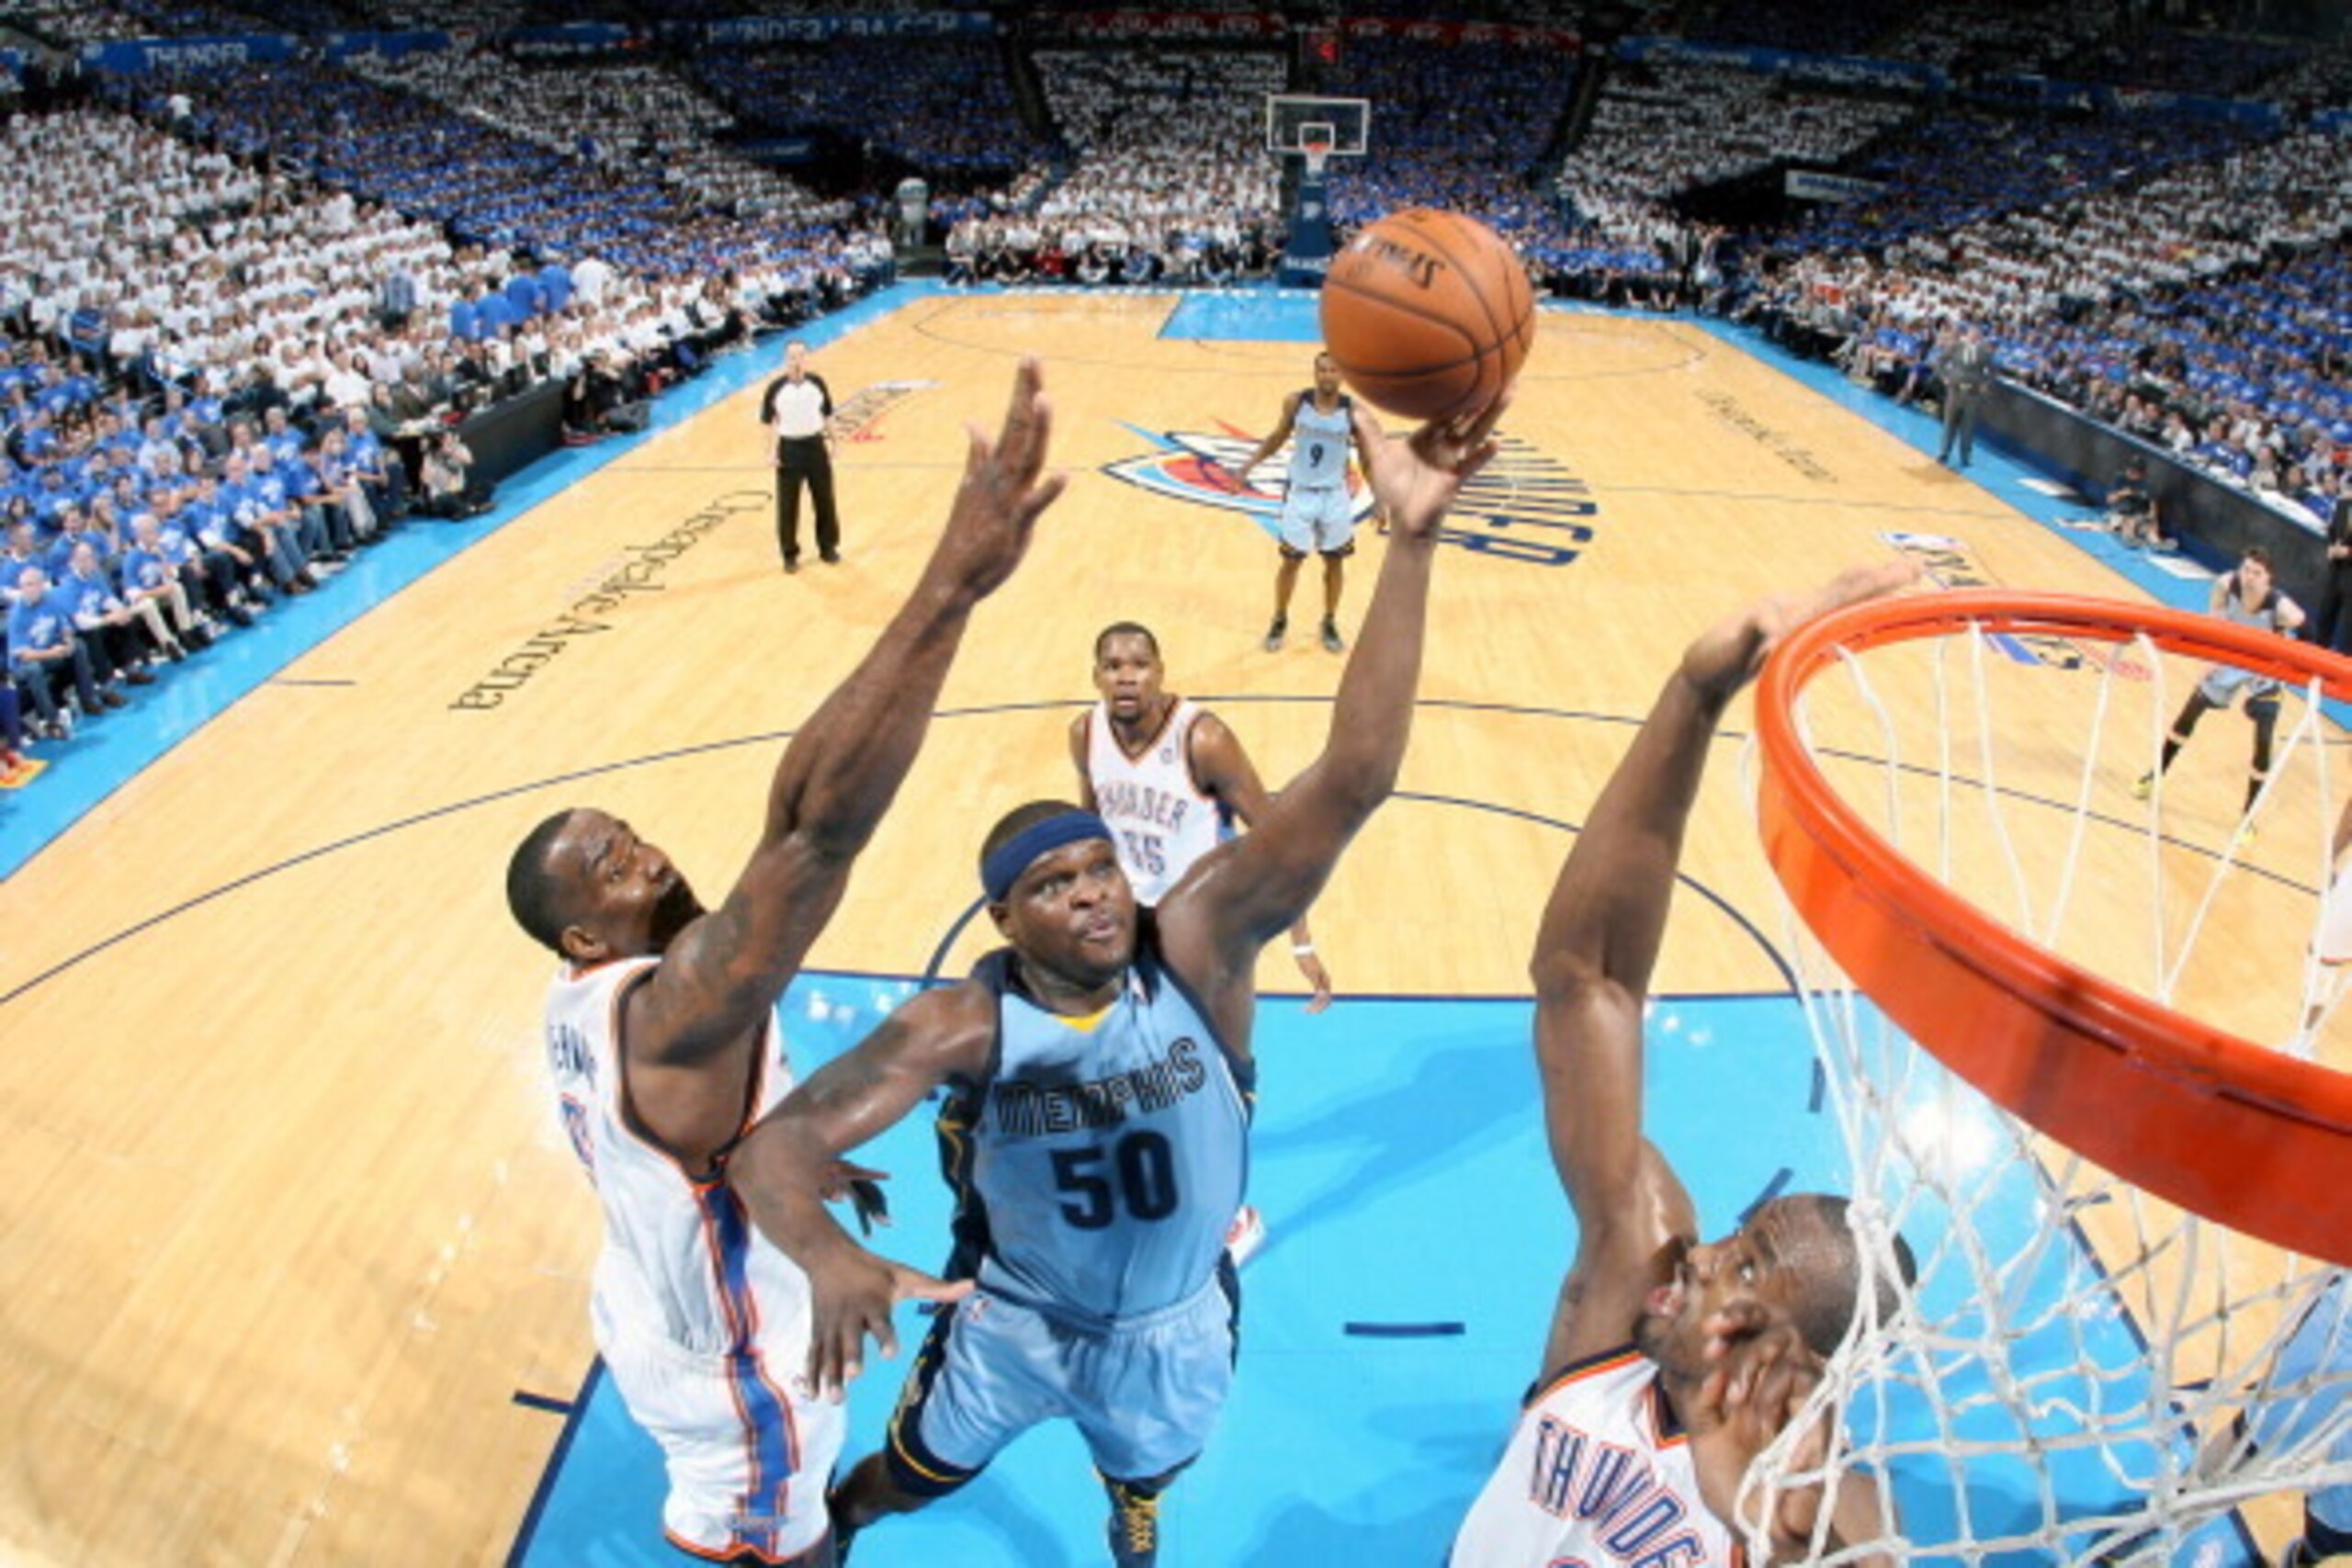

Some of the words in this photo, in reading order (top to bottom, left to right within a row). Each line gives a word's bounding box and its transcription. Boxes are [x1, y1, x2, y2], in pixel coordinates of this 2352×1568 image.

[1309, 442, 1324, 468] 9
[994, 1036, 1205, 1136] MEMPHIS
[1048, 1130, 1179, 1232] 50
